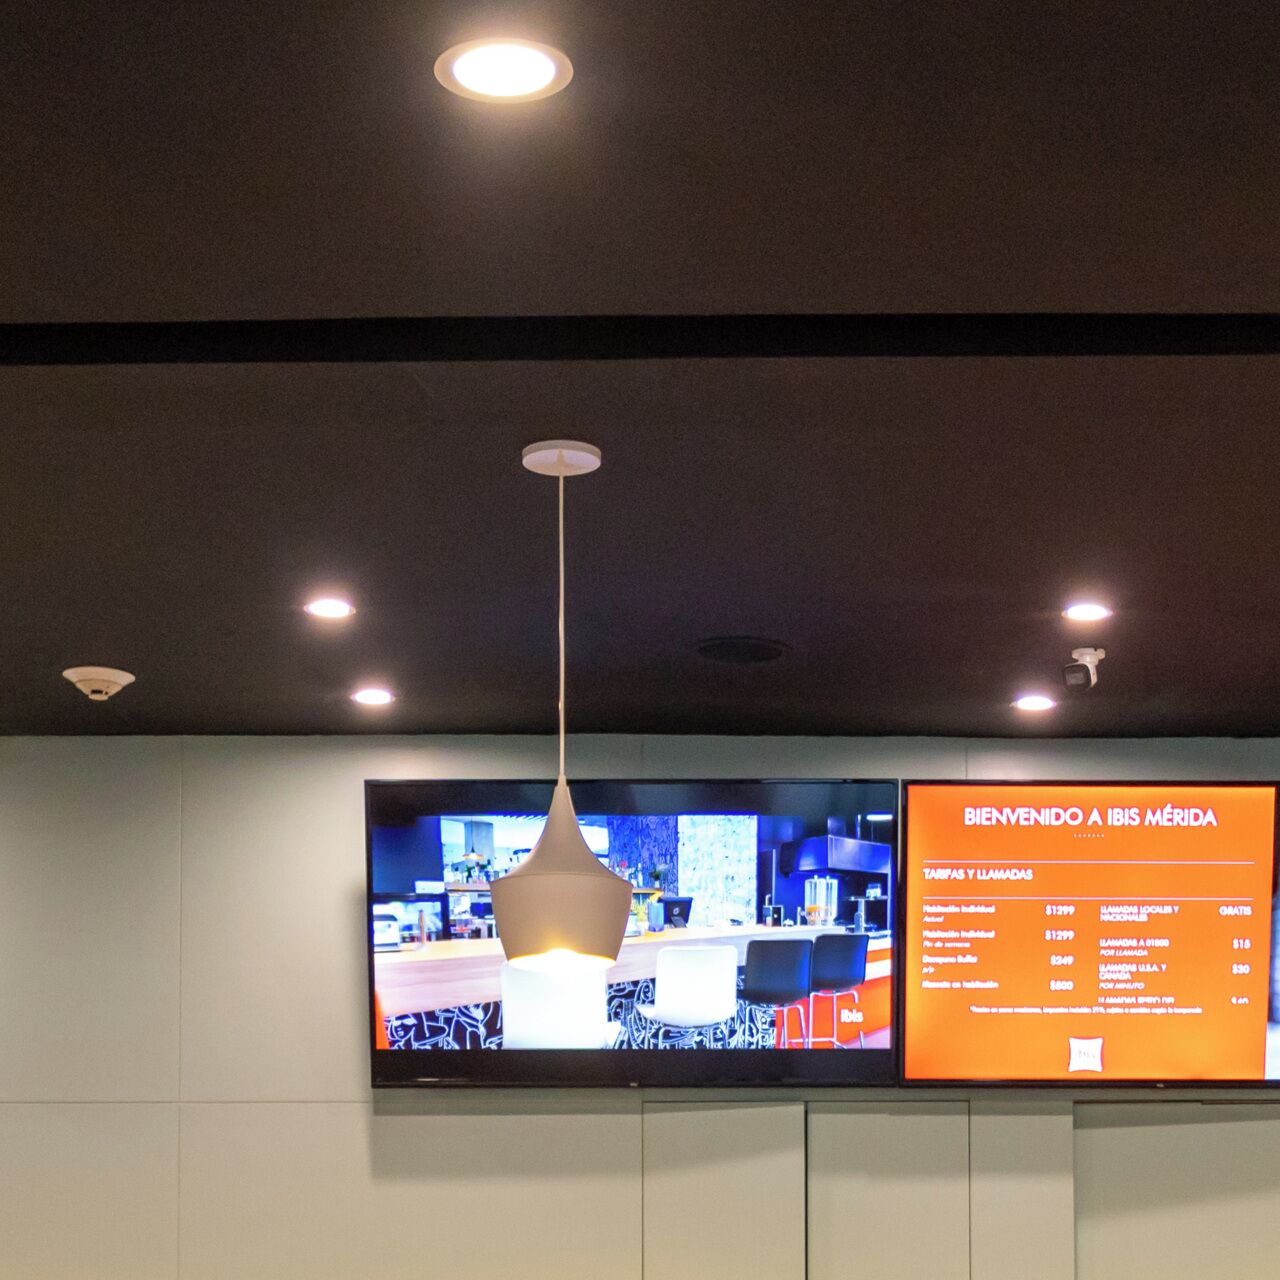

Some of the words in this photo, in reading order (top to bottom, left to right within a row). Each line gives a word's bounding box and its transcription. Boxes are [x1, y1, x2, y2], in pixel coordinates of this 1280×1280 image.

[964, 807, 1083, 826] BIENVENIDO
[1086, 807, 1103, 826] A
[1107, 807, 1140, 826] IBIS
[1144, 803, 1217, 827] MÉRIDA
[923, 868, 965, 880] TARIFAS
[967, 868, 975, 880] Y
[976, 868, 1033, 880] LLAMADAS
[1045, 904, 1075, 916] $1299
[1101, 905, 1138, 914] LLAMADAS
[1140, 905, 1172, 914] LOCALES
[1173, 905, 1179, 914] Y
[1219, 905, 1252, 916] GRATIS
[1101, 913, 1147, 921] NACIONALES
[1045, 929, 1075, 941] $1299
[1100, 939, 1138, 947] LLAMADAS
[1138, 939, 1145, 947] A
[1232, 938, 1251, 949] $15
[1050, 954, 1074, 966] $249
[1099, 964, 1137, 972] LLAMADAS
[1161, 964, 1167, 972] Y
[1232, 963, 1251, 975] $30
